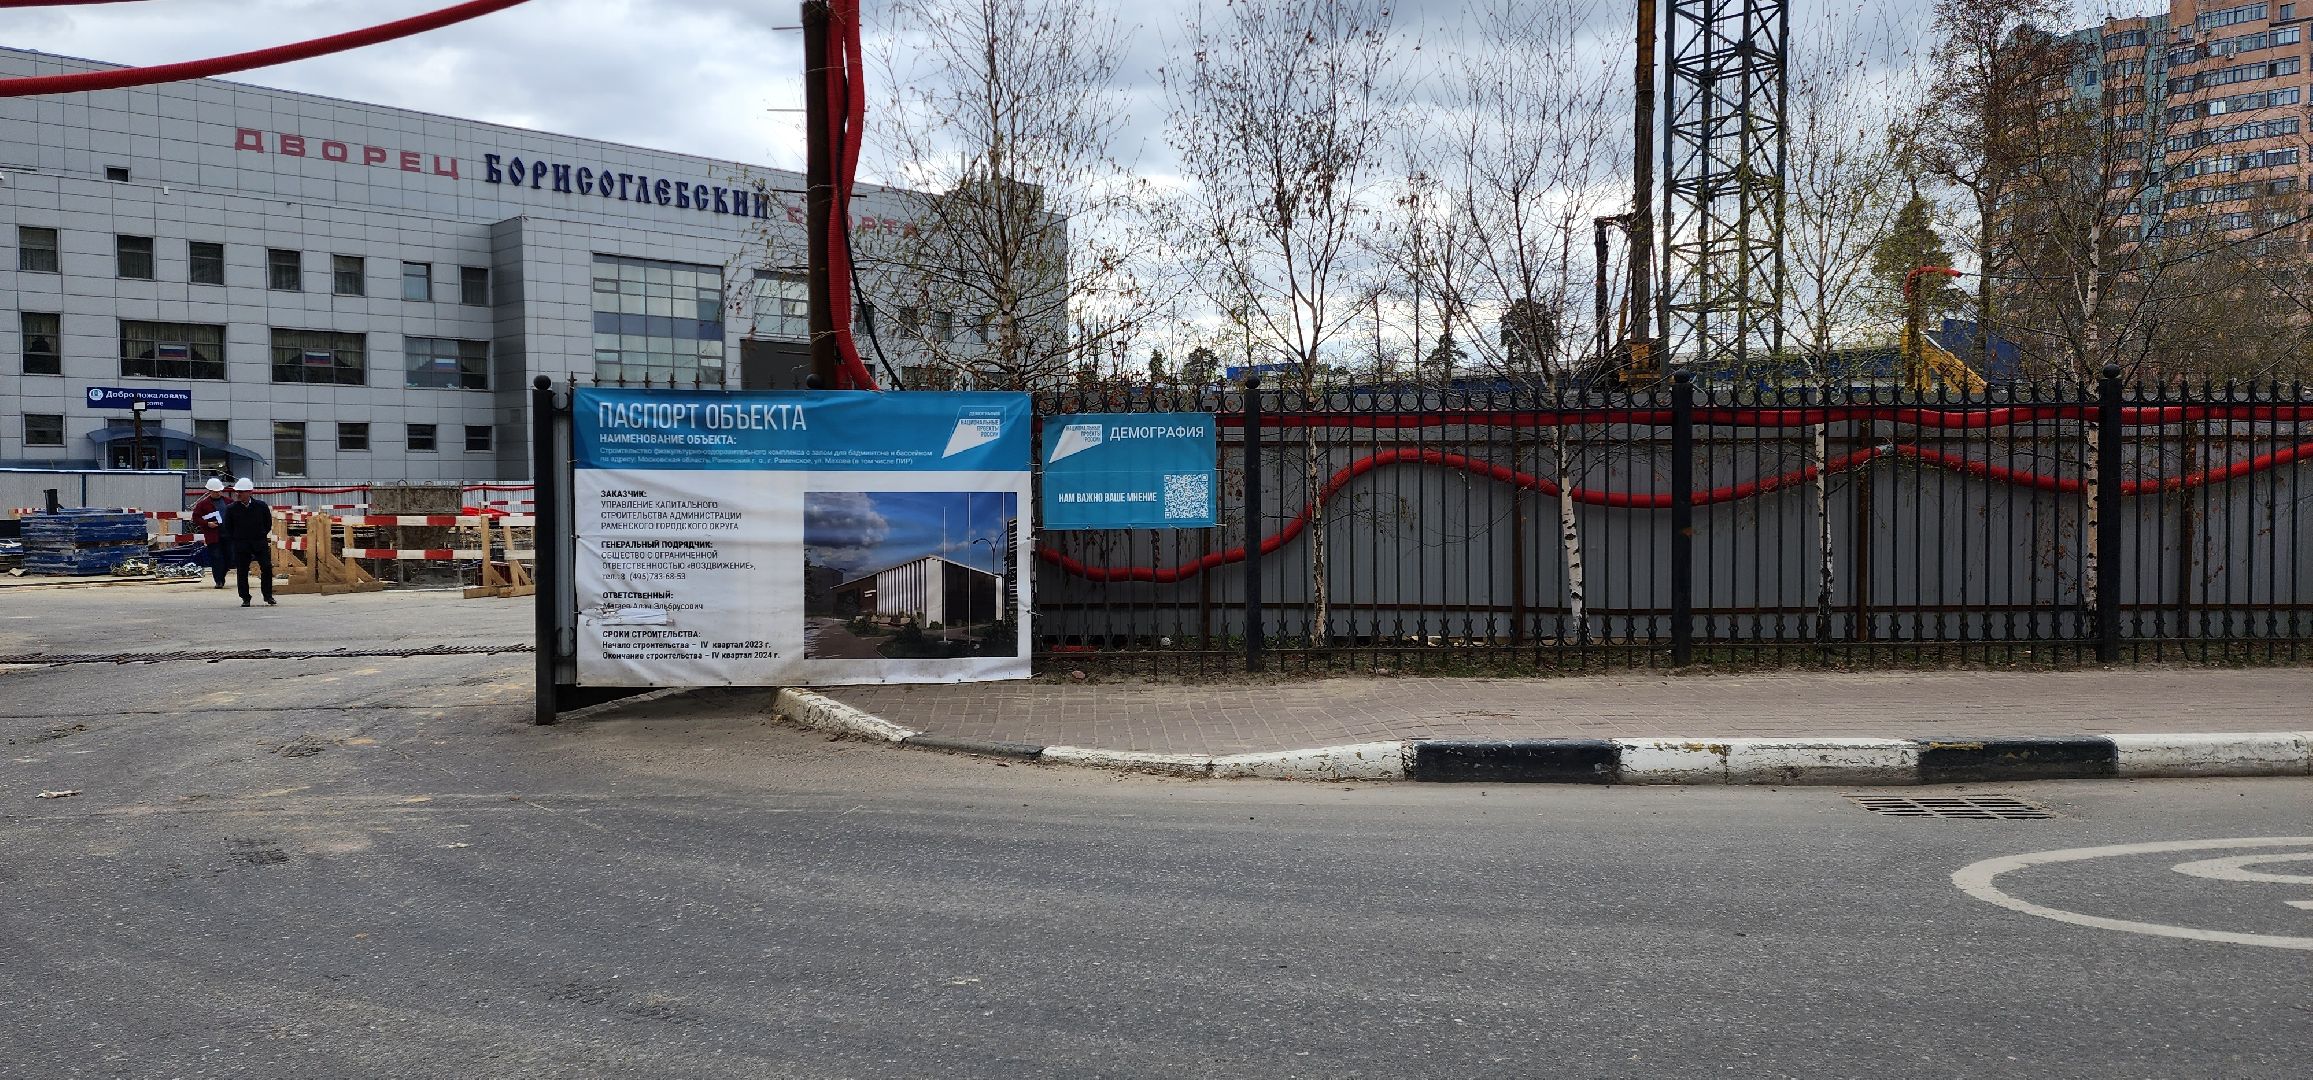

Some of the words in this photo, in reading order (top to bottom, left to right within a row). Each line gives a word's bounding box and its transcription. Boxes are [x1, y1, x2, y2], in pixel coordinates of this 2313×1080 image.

[234, 127, 460, 180] ДВОРЕЦ
[484, 153, 770, 219] БОРИСОГЛЕБСКИЙ
[105, 390, 134, 399] Добро
[136, 392, 189, 400] пожаловать
[599, 402, 700, 429] ПАСПОРТ
[705, 403, 807, 431] ОБЪЕКТА
[1109, 425, 1204, 441] ДЕМОГРАФИЯ
[599, 433, 684, 444] НАИМЕНОВАНИЕ
[687, 434, 737, 445] ОБЪЕКТА:
[600, 489, 647, 498] ЗАКАЗЧИК:
[1058, 493, 1075, 503] НАМ
[1076, 492, 1104, 503] ВАЖНО
[1104, 492, 1126, 503] ВАШЕ
[1126, 491, 1158, 502] МНЕНИЕ
[600, 500, 653, 509] УПРАВЛЕНИЕ
[655, 500, 718, 509] КАПИТАЛЬНОГО
[600, 511, 667, 519] СТРОИТЕЛЬСТВА
[669, 511, 742, 520] АДМИНИСТРАЦИИ
[600, 522, 654, 530] РАМЕНСКОГО
[655, 522, 708, 531] ГОРОДСКОГО
[709, 522, 739, 530] ОКРУГА
[601, 540, 660, 548] ГЕНЕРАЛЬНЫЙ
[661, 541, 713, 549] ПОДРЯДЧИК:
[601, 551, 645, 559] ОБЩЕСТВО
[647, 551, 653, 559] С
[654, 550, 718, 559] ОГРАНИЧЕННОЙ
[602, 562, 685, 570] ОТВЕТСТВЕННОСТЬЮ
[602, 590, 674, 599] ОТВЕТСТВЕННЫЙ:
[653, 602, 704, 611] Эльбрусович
[602, 630, 630, 638] СРОКИ
[631, 630, 701, 638] СТРОИТЕЛЬСТВА:
[602, 641, 630, 649] Начало
[632, 641, 690, 650] строительства
[700, 641, 709, 649] IV
[712, 642, 744, 650] квартал
[744, 641, 764, 649] 2023
[602, 652, 644, 660] Окончание
[646, 652, 703, 661] строительства
[711, 652, 720, 660] IV
[721, 652, 752, 661] квартал
[753, 652, 773, 660] 2024
